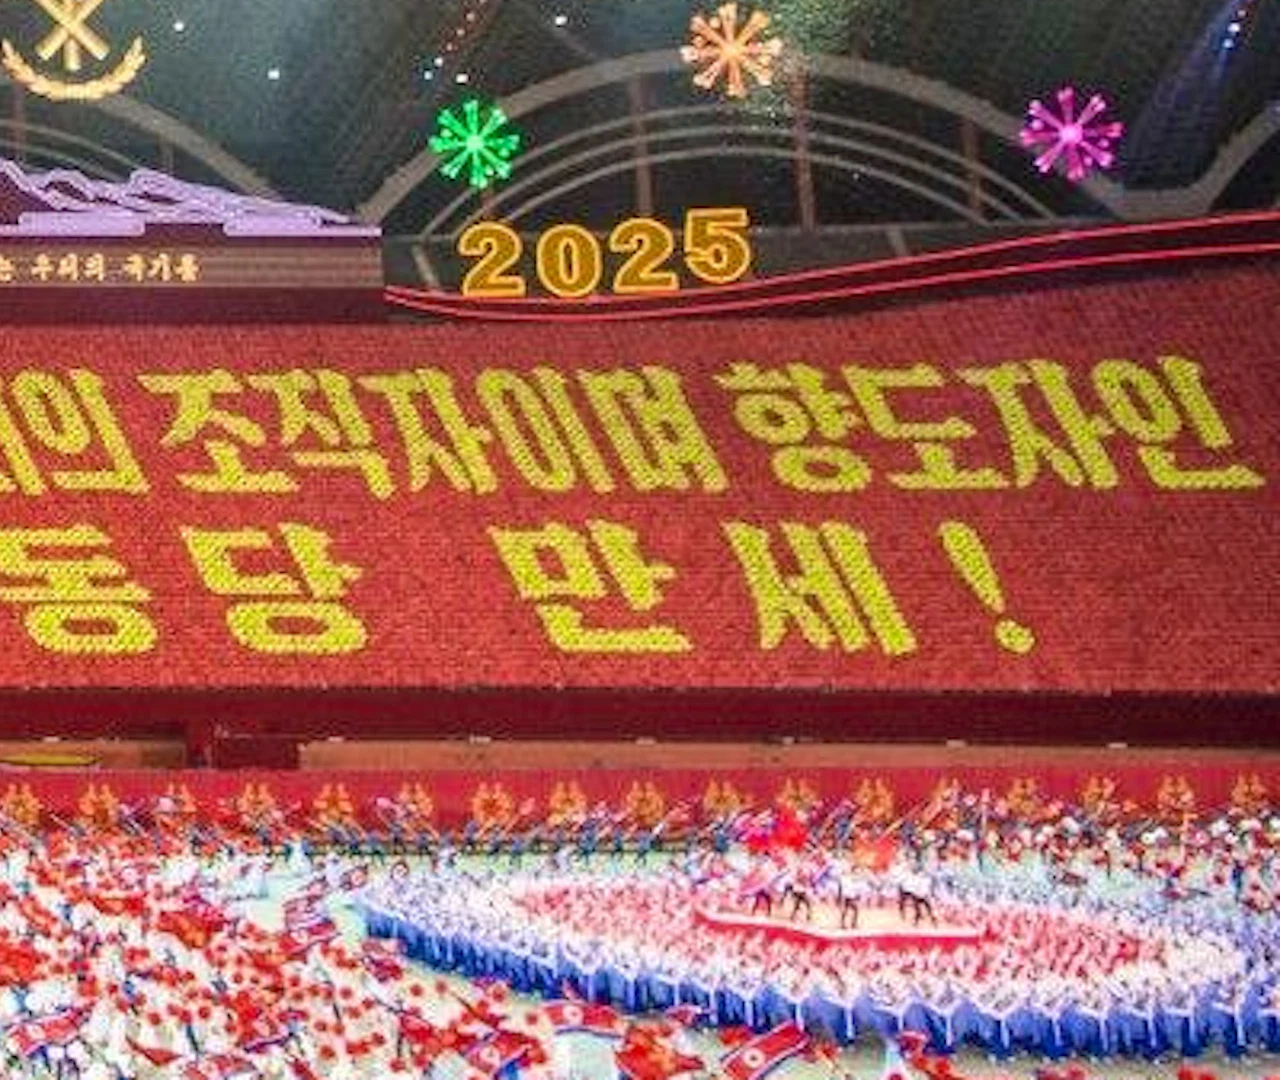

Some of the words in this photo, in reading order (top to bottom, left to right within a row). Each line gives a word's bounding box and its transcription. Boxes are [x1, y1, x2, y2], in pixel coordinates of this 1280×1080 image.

[456, 207, 753, 301] 2025
[137, 365, 730, 501] 조직자이며
[713, 355, 1266, 493] 향도자인
